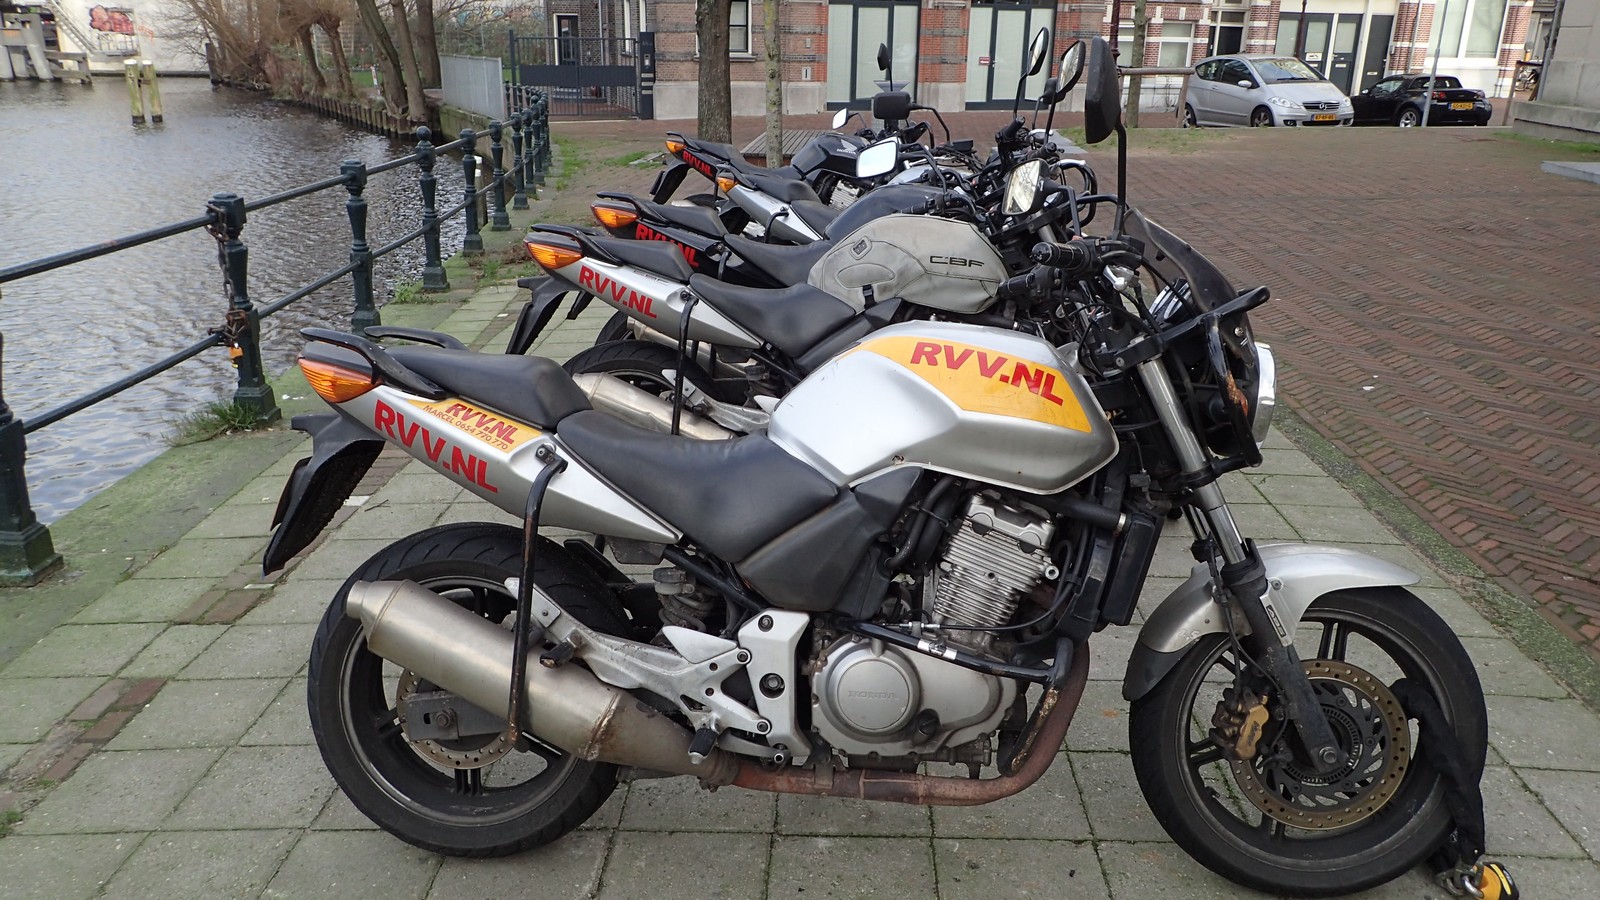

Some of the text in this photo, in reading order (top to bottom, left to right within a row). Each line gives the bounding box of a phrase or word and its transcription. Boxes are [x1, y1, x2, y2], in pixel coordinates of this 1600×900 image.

[683, 150, 713, 176] RVV.NL
[929, 255, 985, 268] CBF
[579, 265, 657, 319] RVV.NL
[910, 341, 1064, 406] RVV.NL
[422, 405, 509, 450] MARCEL 0654 770 770
[445, 403, 519, 445] RVV.NL
[374, 399, 498, 494] RVV.NL
[848, 690, 898, 699] HONDA
